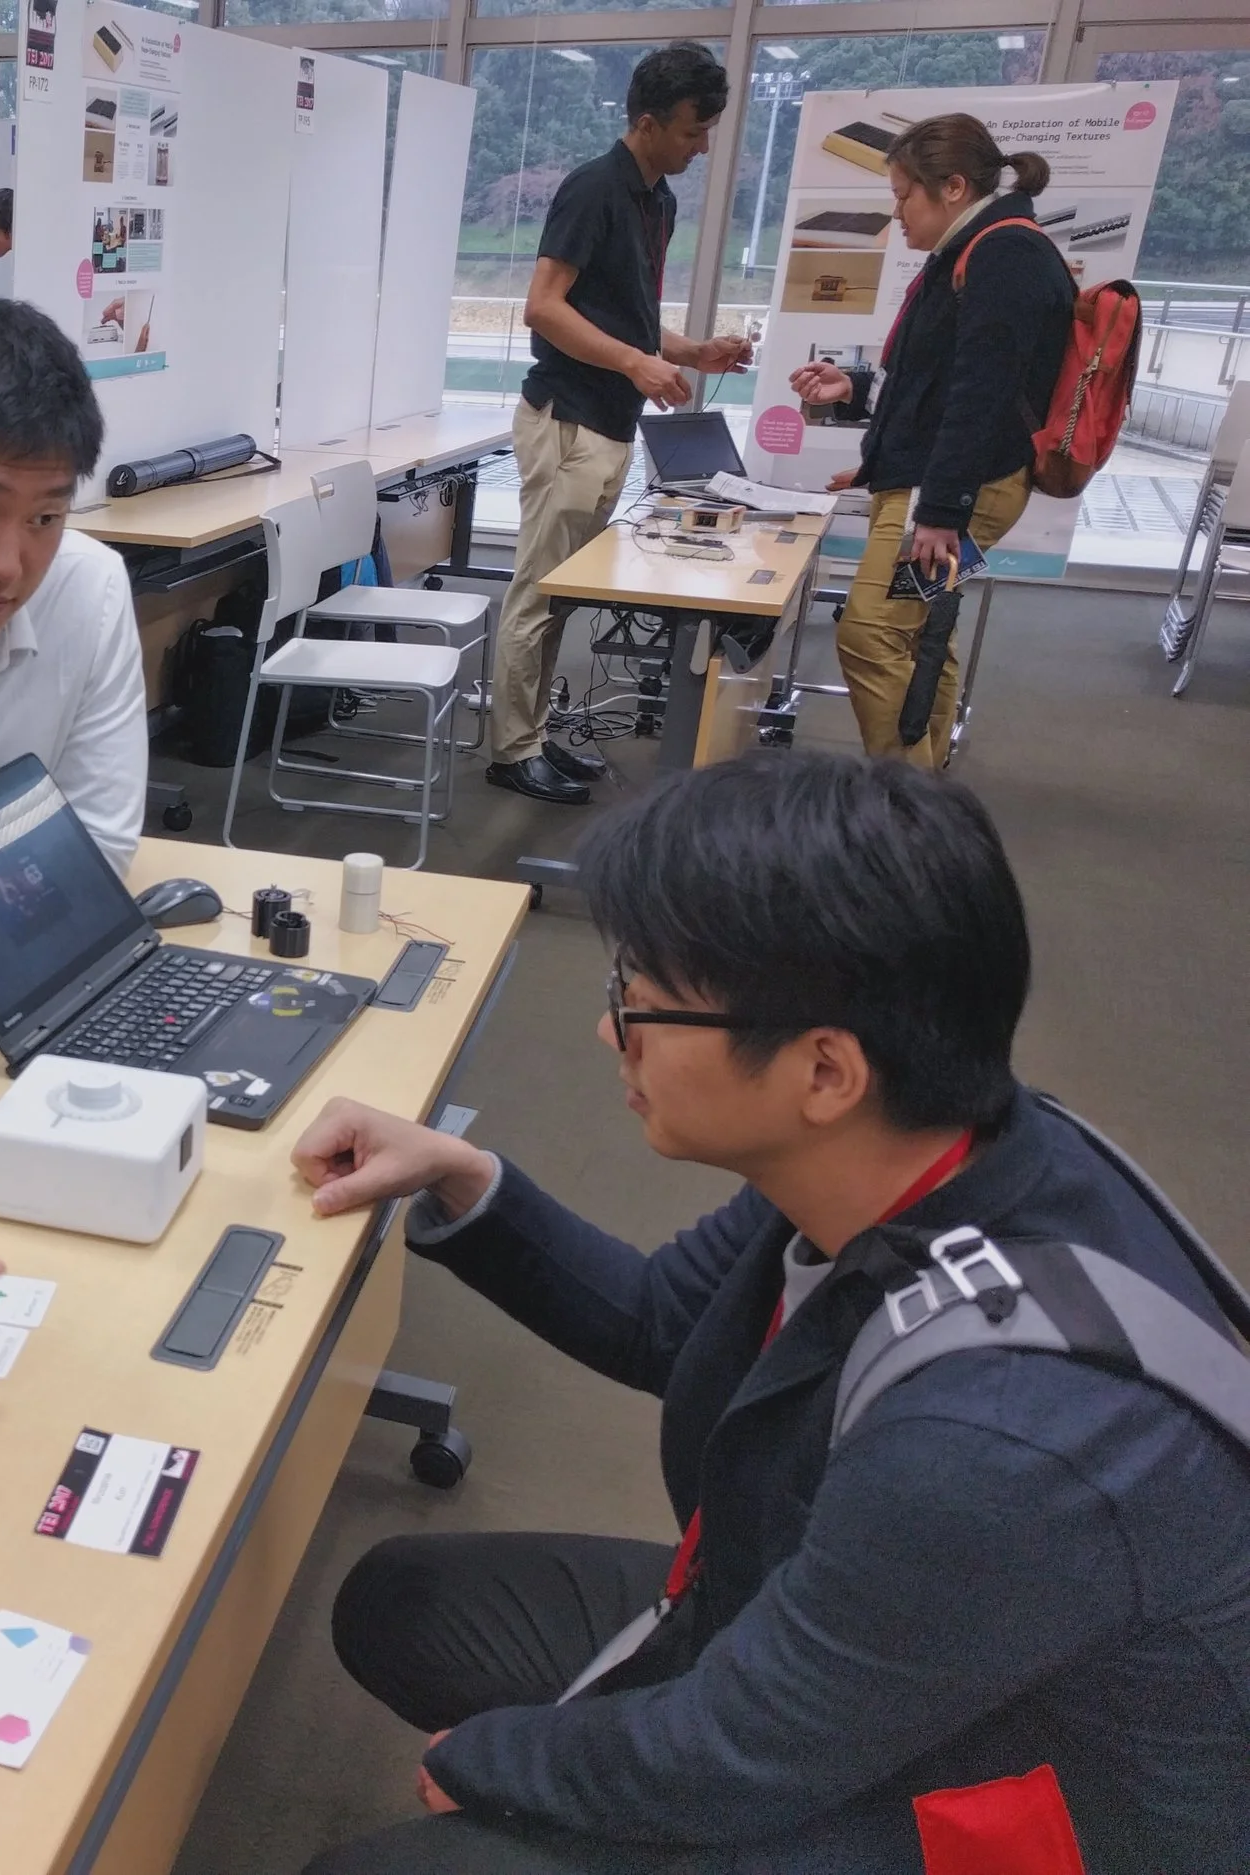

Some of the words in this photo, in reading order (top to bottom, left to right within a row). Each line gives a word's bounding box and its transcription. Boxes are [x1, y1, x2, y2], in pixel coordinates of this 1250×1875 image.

[986, 120, 998, 129] An
[1002, 119, 1063, 130] Exploration
[1068, 119, 1080, 128] of
[1085, 117, 1120, 128] Mobile
[1066, 131, 1111, 141] Textures
[37, 1511, 61, 1534] TEI
